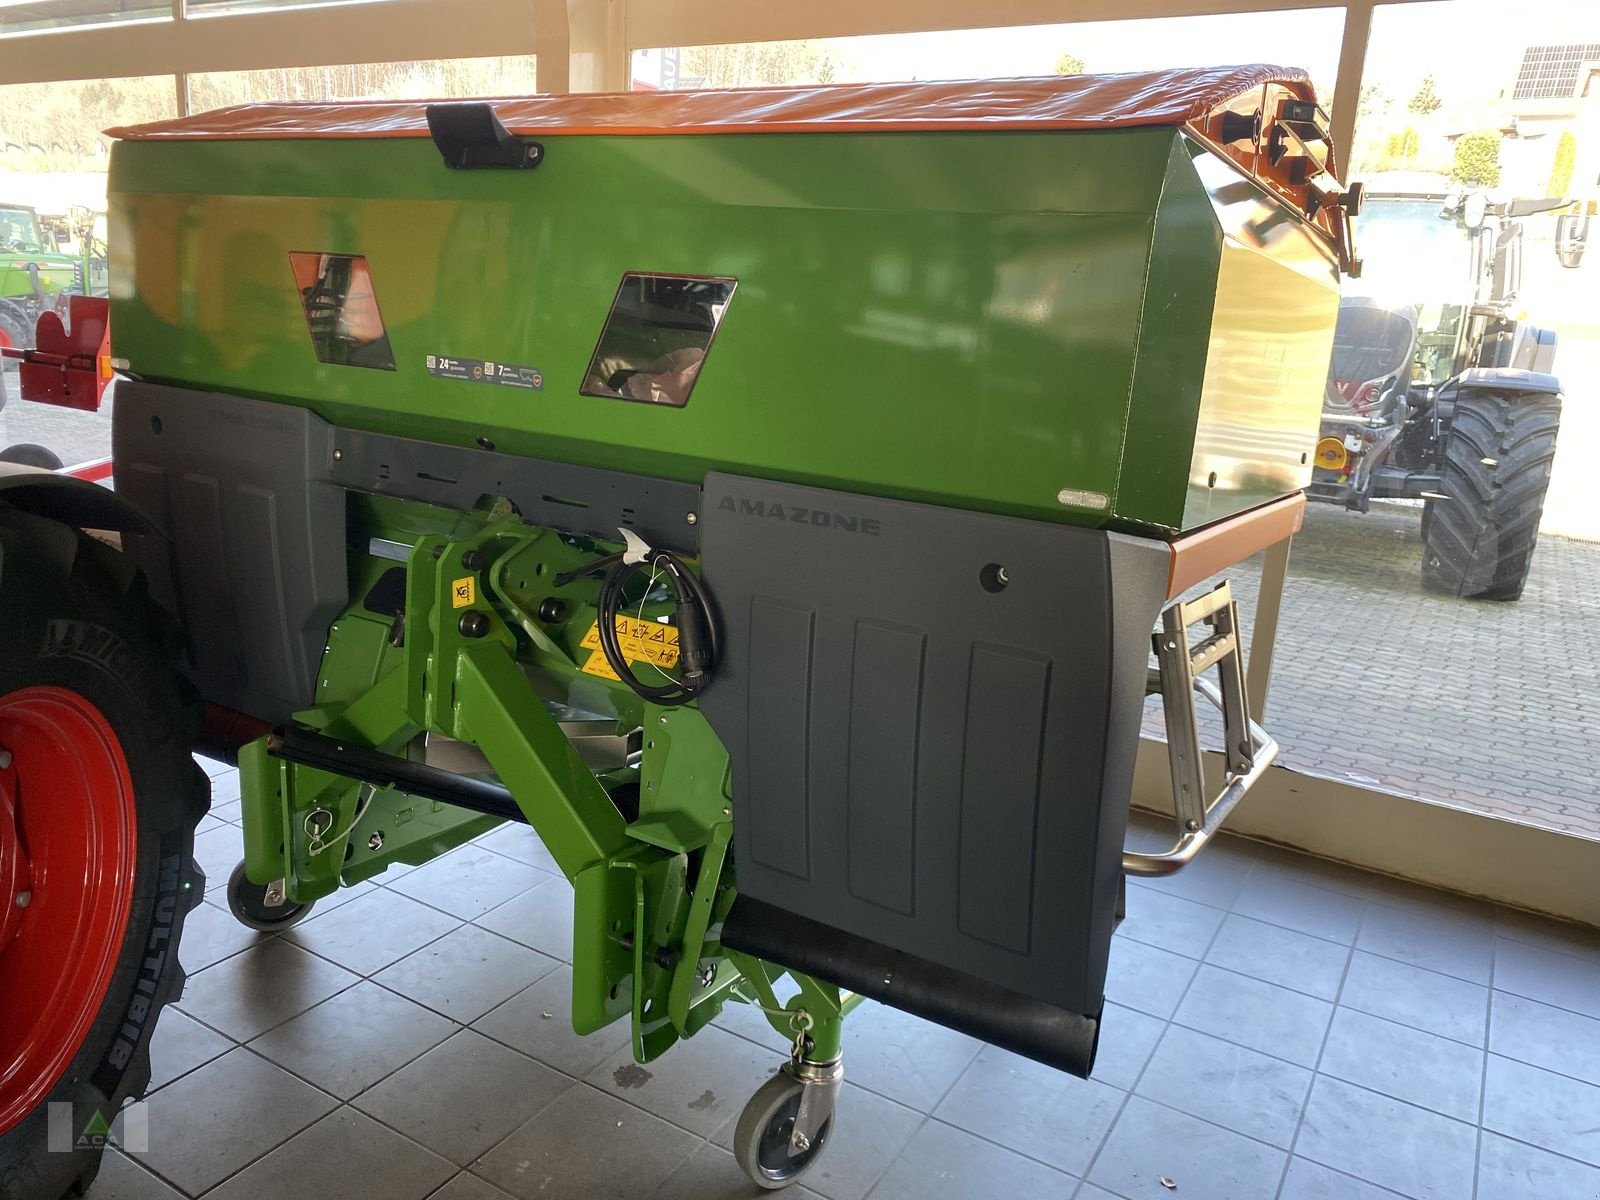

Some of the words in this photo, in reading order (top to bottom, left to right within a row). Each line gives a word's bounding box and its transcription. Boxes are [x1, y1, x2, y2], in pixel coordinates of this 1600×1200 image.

[439, 358, 449, 369] 24
[497, 365, 504, 376] 7
[718, 495, 881, 536] AMAZONE
[108, 853, 181, 1071] MULTIBIB
